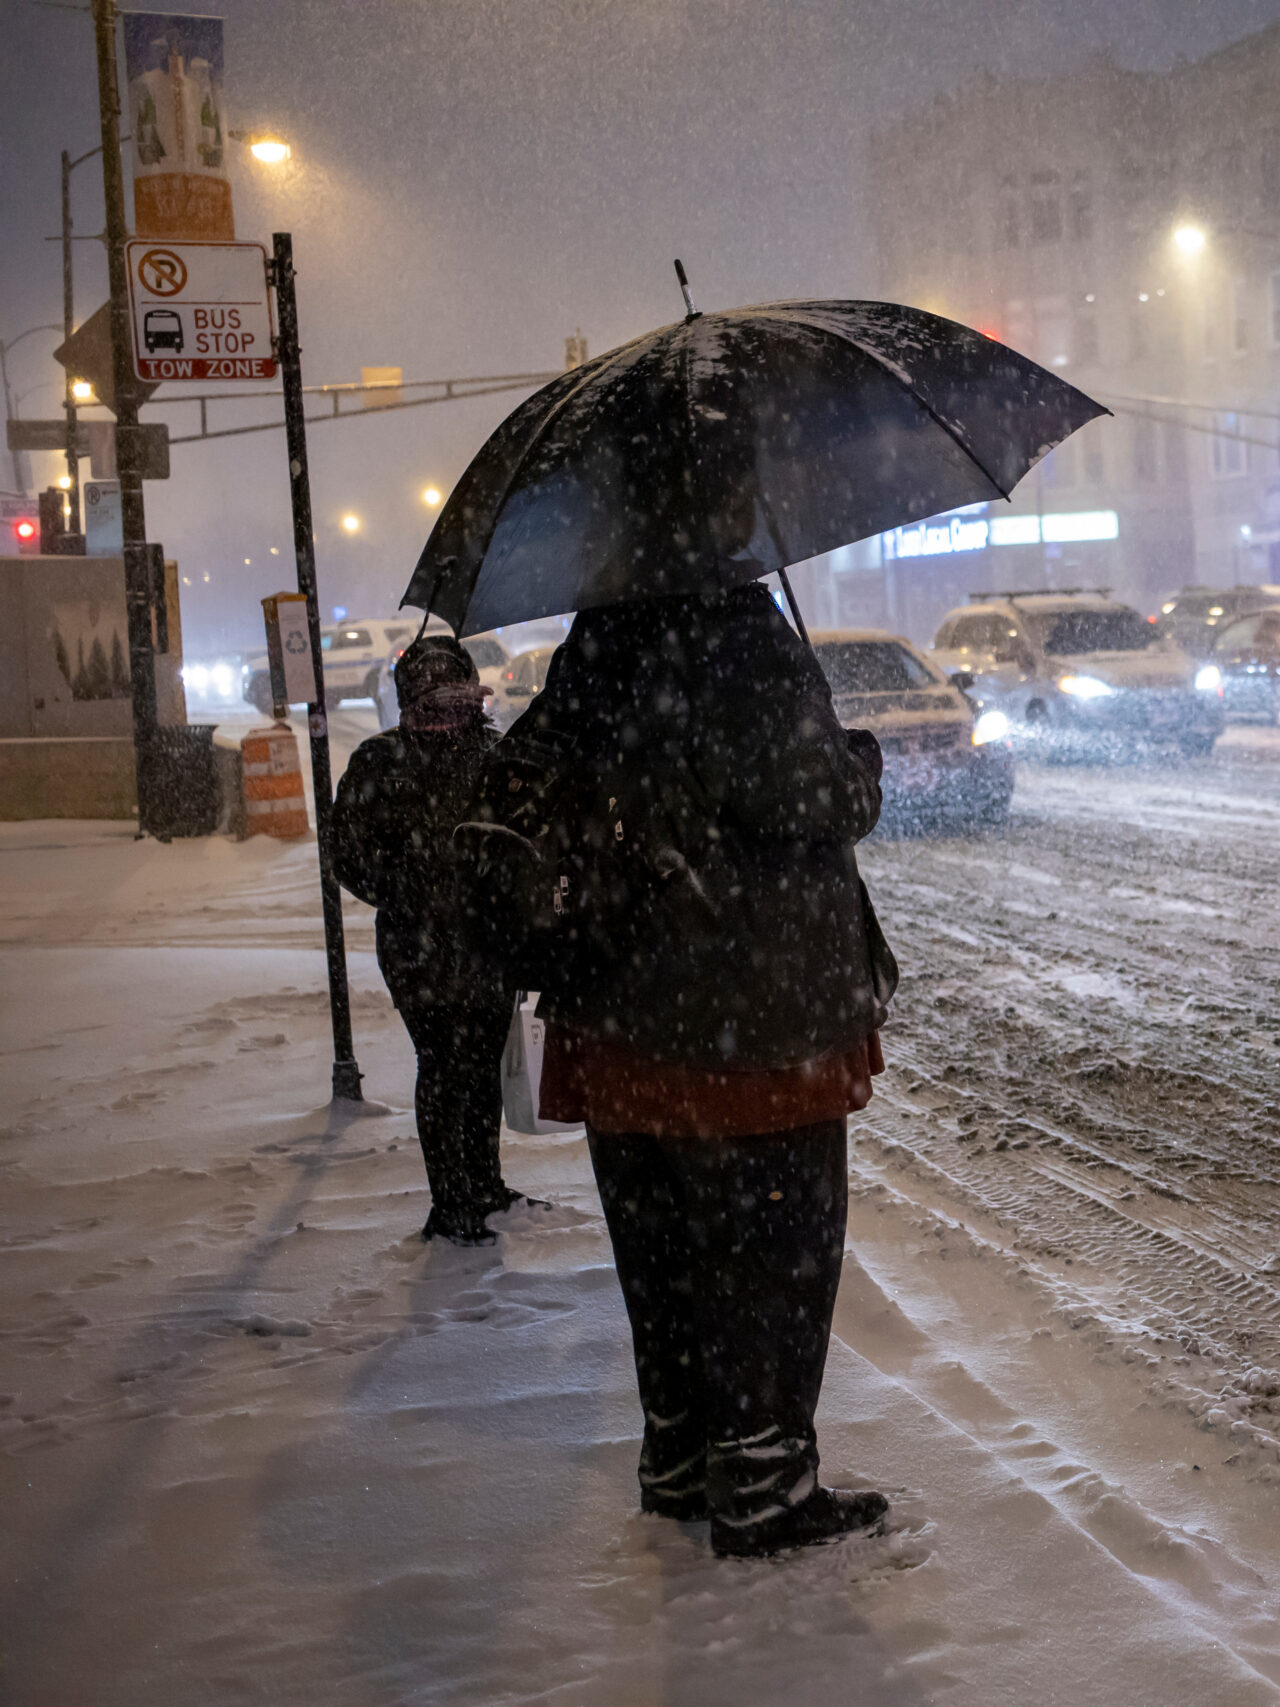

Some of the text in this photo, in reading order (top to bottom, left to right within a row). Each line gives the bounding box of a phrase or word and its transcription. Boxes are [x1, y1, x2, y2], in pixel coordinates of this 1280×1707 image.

[194, 309, 241, 329] BUS
[196, 333, 255, 353] STOP
[145, 360, 264, 377] TOW ZONE
